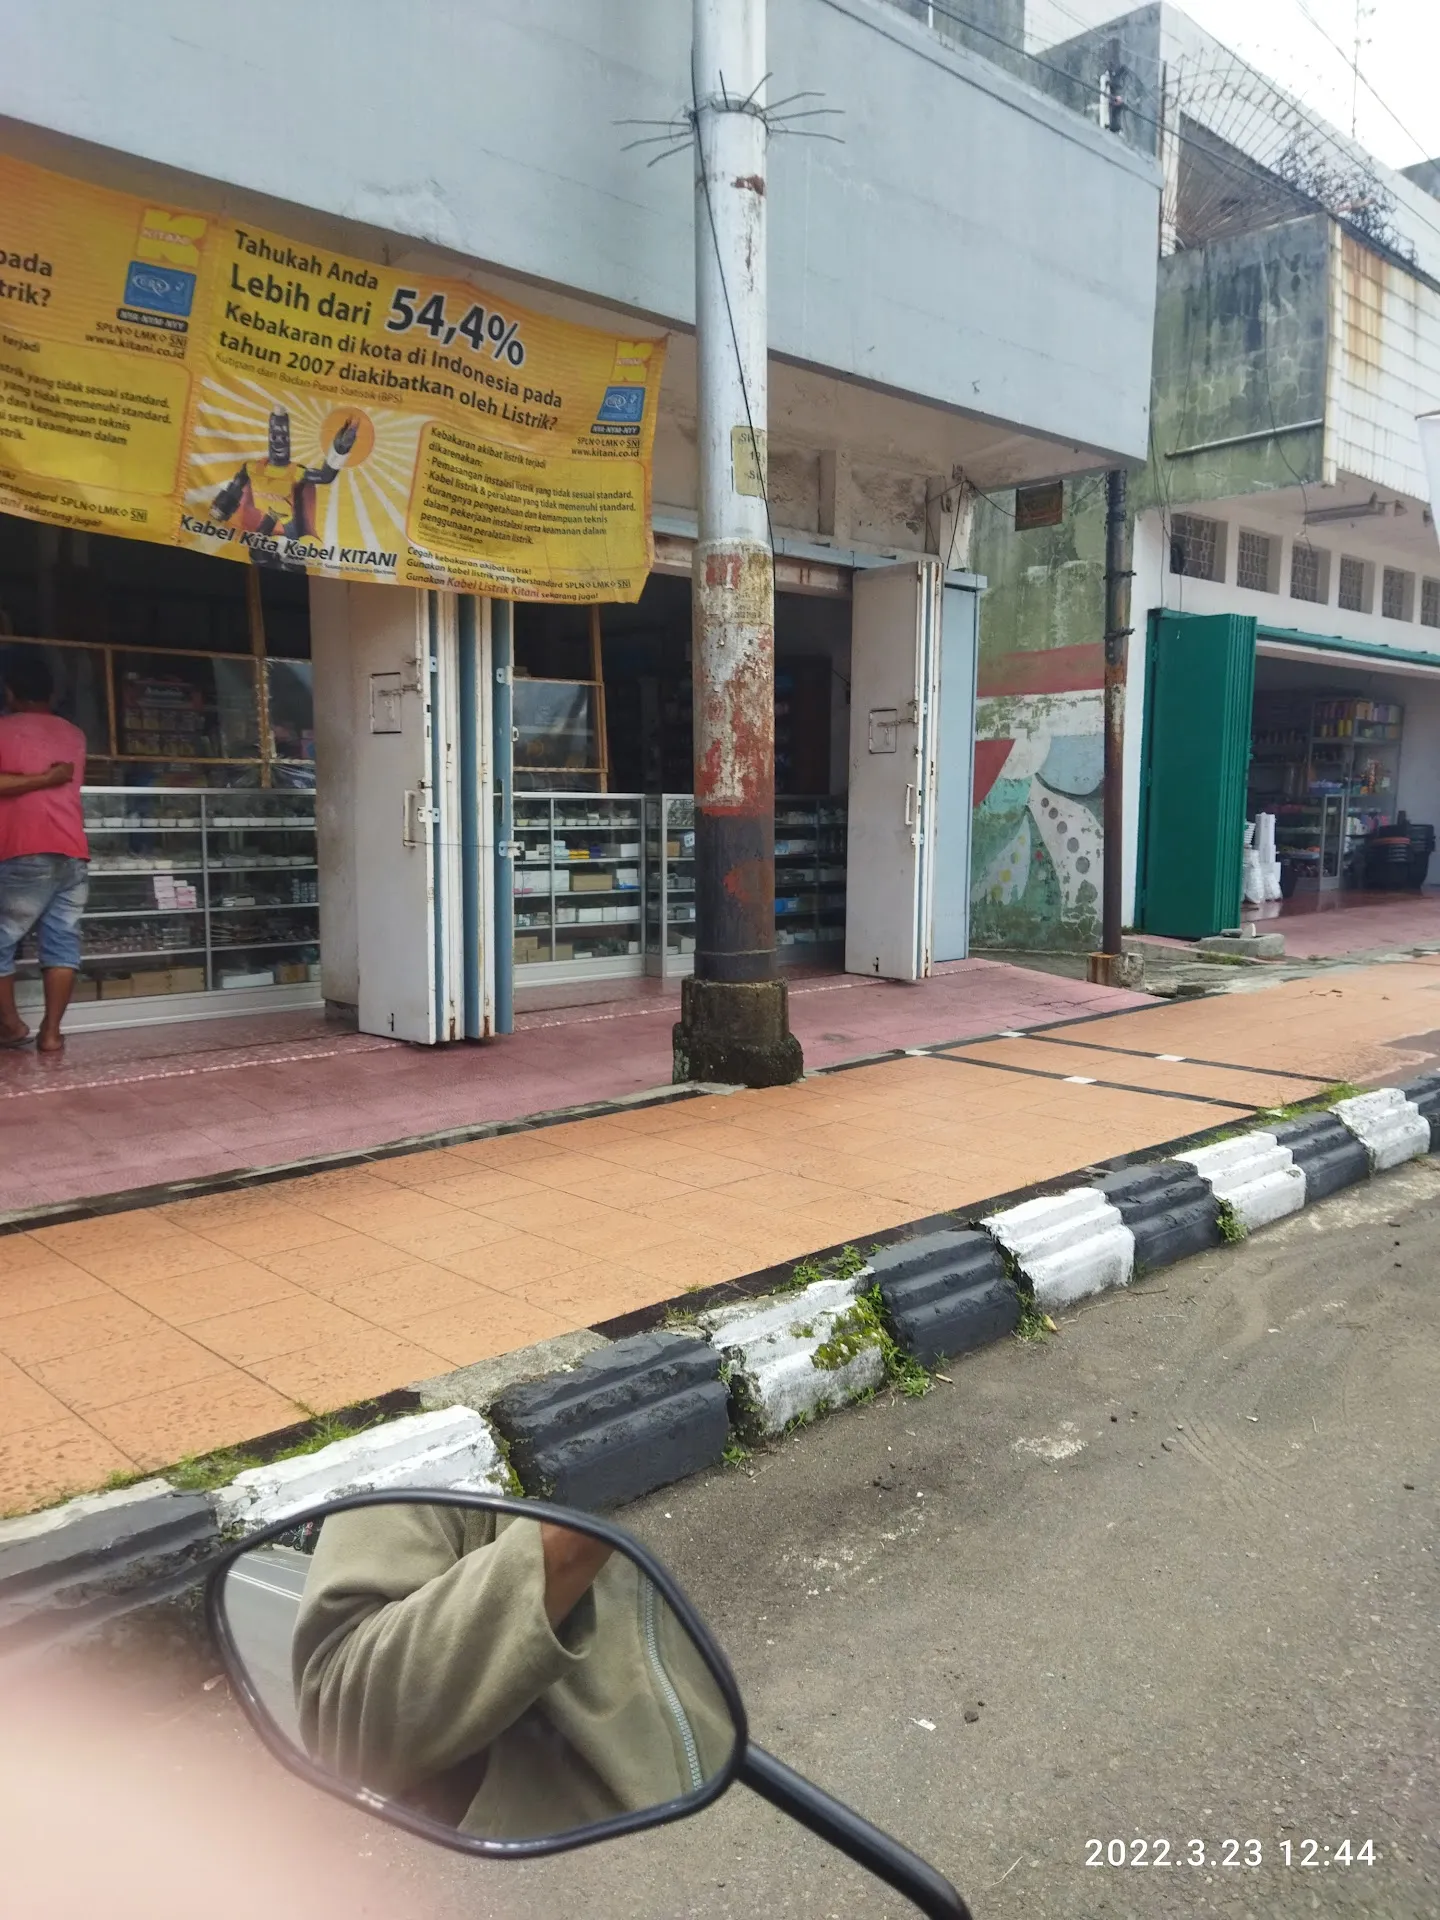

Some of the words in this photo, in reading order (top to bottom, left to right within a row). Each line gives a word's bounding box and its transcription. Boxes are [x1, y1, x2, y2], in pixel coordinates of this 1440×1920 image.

[235, 228, 323, 276] Tahukah
[326, 261, 379, 291] Anda
[0, 280, 51, 307] trik?
[96, 321, 122, 335] SPLN
[134, 329, 157, 341] LMK
[231, 262, 310, 312] Lebih
[317, 291, 372, 326] dari
[386, 287, 525, 367] 54,4%
[2, 335, 40, 353] terjadi
[85, 334, 185, 360] www.kitani.co.id
[225, 300, 333, 349] Kebakaran
[337, 334, 357, 354] di
[360, 337, 402, 362] kota
[407, 346, 427, 366] di
[431, 350, 519, 396] Indonesia
[522, 385, 562, 408] pada
[0, 363, 24, 378] strik
[27, 373, 54, 390] yang
[56, 379, 83, 393] tidak
[86, 386, 118, 398] sesuai
[120, 390, 169, 409] standard.
[219, 330, 281, 365] tahun
[286, 351, 335, 377] 2007
[339, 362, 455, 400] diakibatkan
[459, 390, 498, 416] oleh
[501, 402, 558, 431] Listrik?
[3, 380, 31, 397] yang
[34, 388, 60, 404] tidak
[64, 397, 120, 414] memenuhi
[121, 406, 172, 424] standard.
[7, 395, 27, 408] dan
[30, 401, 96, 424] kemampuan
[98, 415, 131, 431] teknis
[8, 413, 33, 426] serta
[36, 417, 92, 438] keamanan
[94, 430, 127, 445] dalam
[577, 436, 595, 446] SPLN
[602, 439, 618, 447] LMK
[428, 441, 483, 468] dikarenakan:
[431, 427, 476, 450] Kebakaran
[477, 444, 503, 459] akibat
[503, 451, 524, 465] listrik
[525, 456, 547, 469] terjadi
[571, 447, 640, 458] www.kitani.co.id
[428, 470, 454, 486] Kabel
[455, 478, 478, 493] listrik
[487, 489, 521, 504] peralatan
[522, 498, 539, 508] yang
[540, 498, 557, 509] tidak
[558, 503, 598, 512] memenuhi
[599, 502, 636, 512] standard.
[431, 456, 483, 481] Pemasangan
[484, 473, 515, 489] instalasi
[515, 480, 534, 493] listrik
[535, 486, 552, 498] yang
[552, 487, 571, 498] tidak
[571, 490, 595, 499] sesuai
[596, 489, 634, 499] standard.
[0, 482, 58, 503] erstandard
[60, 495, 87, 511] SPLN
[98, 505, 121, 517] LMK
[23, 503, 74, 523] sekarang
[423, 498, 449, 512] dalam
[450, 507, 492, 524] pekerjaan
[492, 516, 524, 531] instalasi
[524, 523, 541, 532] serta
[542, 524, 581, 535] keamanan
[582, 526, 607, 535] dalam
[426, 483, 472, 506] Kurangnya
[473, 500, 523, 518] pengetahuan
[524, 510, 538, 518] dan
[538, 511, 582, 524] kemampuan
[583, 515, 608, 524] teknis
[180, 513, 236, 542] Kabel
[239, 530, 280, 553] Kita
[284, 538, 336, 561] Kabel
[339, 547, 398, 568] KITANI
[420, 512, 473, 533] penggunaan
[474, 527, 511, 542] peralatan
[511, 534, 535, 545] listrik.
[406, 558, 446, 573] Gunakan
[447, 564, 470, 576] kabel
[471, 569, 496, 580] listrik
[495, 573, 516, 585] yang
[516, 576, 563, 589] berstandard
[565, 580, 585, 589] SPLN
[592, 580, 610, 589] LMK
[407, 546, 433, 560] Cegah
[435, 552, 478, 568] kebakaran
[479, 561, 506, 573] akibat
[506, 564, 532, 576] listrik!
[406, 572, 445, 585] Gunakan
[446, 576, 476, 590] Kabel
[478, 581, 509, 595] Listrik
[510, 584, 540, 598] Kitani
[541, 591, 577, 601] sekarang
[577, 592, 599, 601] juga!
